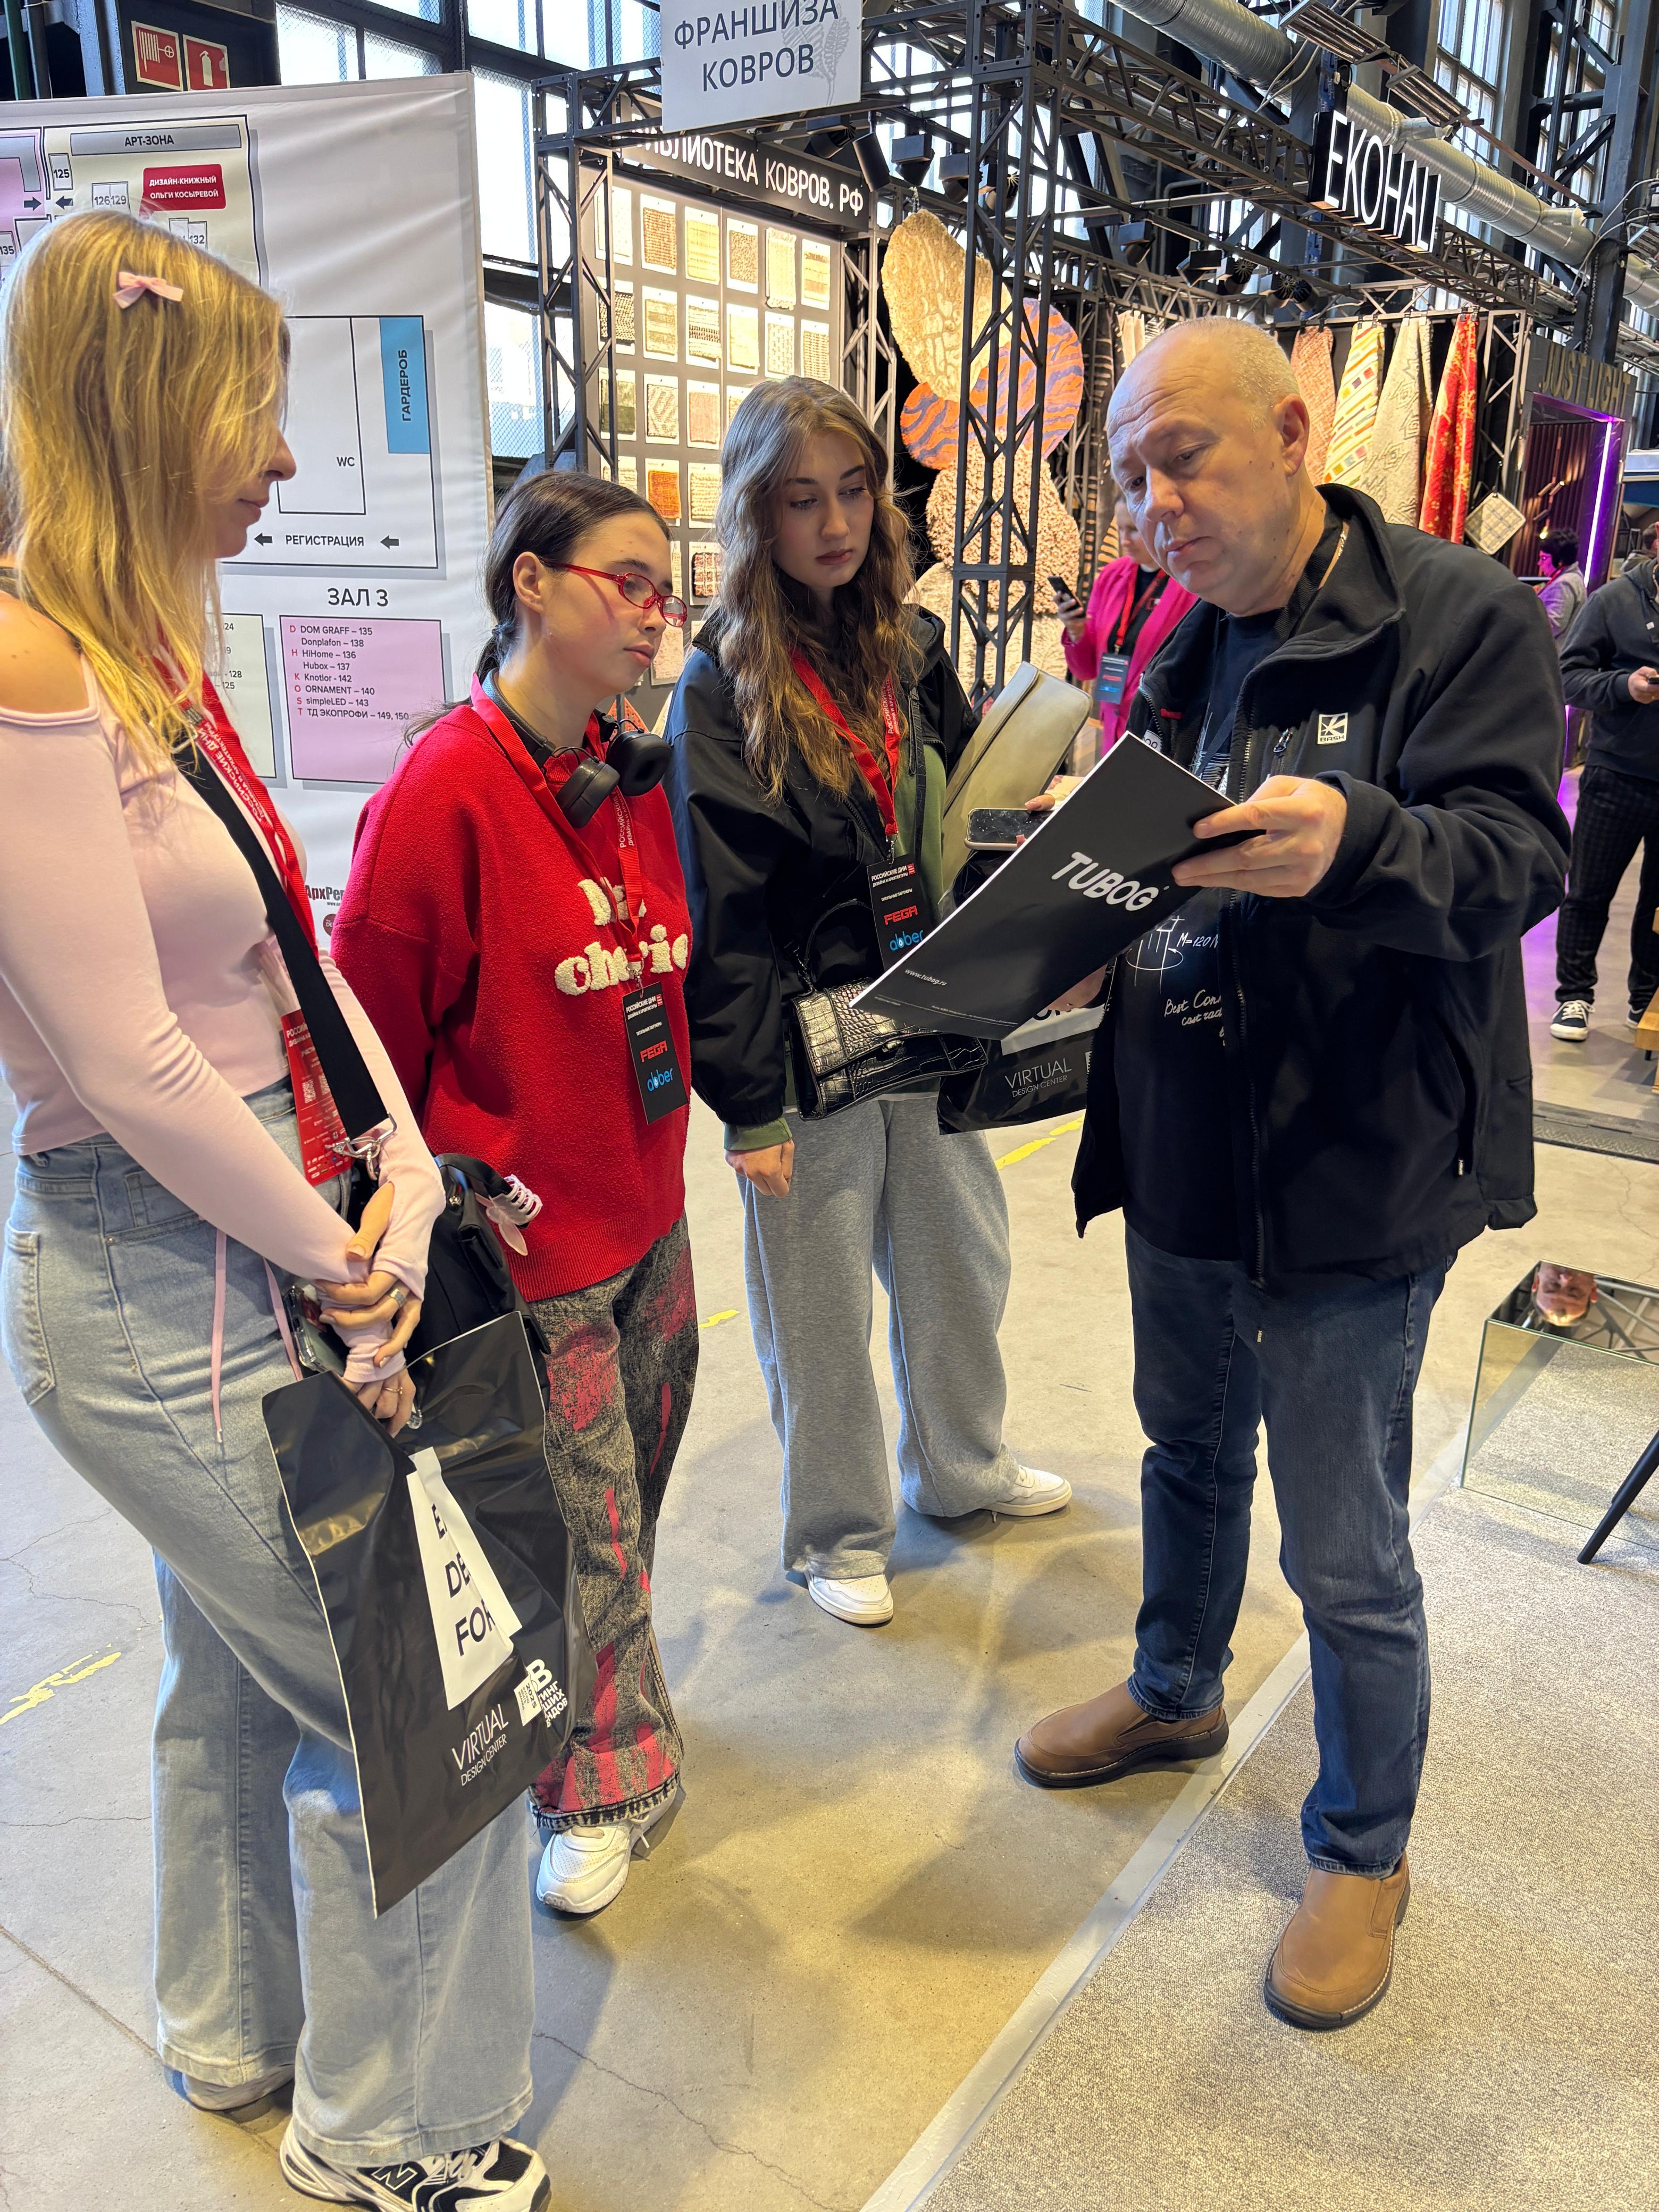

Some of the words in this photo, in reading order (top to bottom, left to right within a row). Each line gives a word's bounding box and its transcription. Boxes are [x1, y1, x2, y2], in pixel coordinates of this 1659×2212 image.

[674, 0, 839, 49] ФРАНШИЗА
[702, 44, 814, 91] КОВРОВ
[124, 135, 174, 147] АРТ-ЗОНА
[53, 169, 70, 179] 125
[149, 177, 216, 187] ДИЗАЙН-КНИЖНЫЙ
[175, 189, 219, 198] КОСЫРЕВОЙ
[766, 158, 834, 209] КОВРОВ.
[839, 183, 864, 217] РФ
[94, 196, 110, 206] 126
[110, 195, 127, 205] 129
[189, 235, 205, 244] 132
[398, 349, 412, 422] ГАРДЕРОБ
[1540, 343, 1587, 405] JUST
[1586, 359, 1631, 418] LIGHT
[337, 457, 355, 467] WC
[286, 535, 364, 547] РЕГИСТРАЦИЯ
[327, 588, 370, 607] ЗАЛ
[376, 589, 389, 607] 3
[322, 626, 349, 635] GRAFF
[301, 638, 341, 647] Donplafon
[305, 686, 352, 694] ORNAMENT
[307, 708, 319, 717] ТД
[320, 709, 368, 718] ЭКОПРОФИ
[377, 711, 393, 720] 149,
[197, 727, 219, 751] ДНИ
[898, 865, 907, 874] ДНИ
[1051, 852, 1159, 911] TUBOG
[884, 905, 918, 926] FEGA
[905, 968, 948, 986] www.tubog.ru
[1164, 999, 1189, 1017] Best
[640, 1040, 668, 1062] FEGA
[1005, 1058, 1072, 1088] VIRTUAL
[1012, 1084, 1039, 1097] DESIGN
[1040, 1075, 1068, 1088] CENTER
[452, 1704, 509, 1770] VIRTUAL
[461, 1757, 486, 1787] DESIGN
[485, 1734, 507, 1762] CENTER
